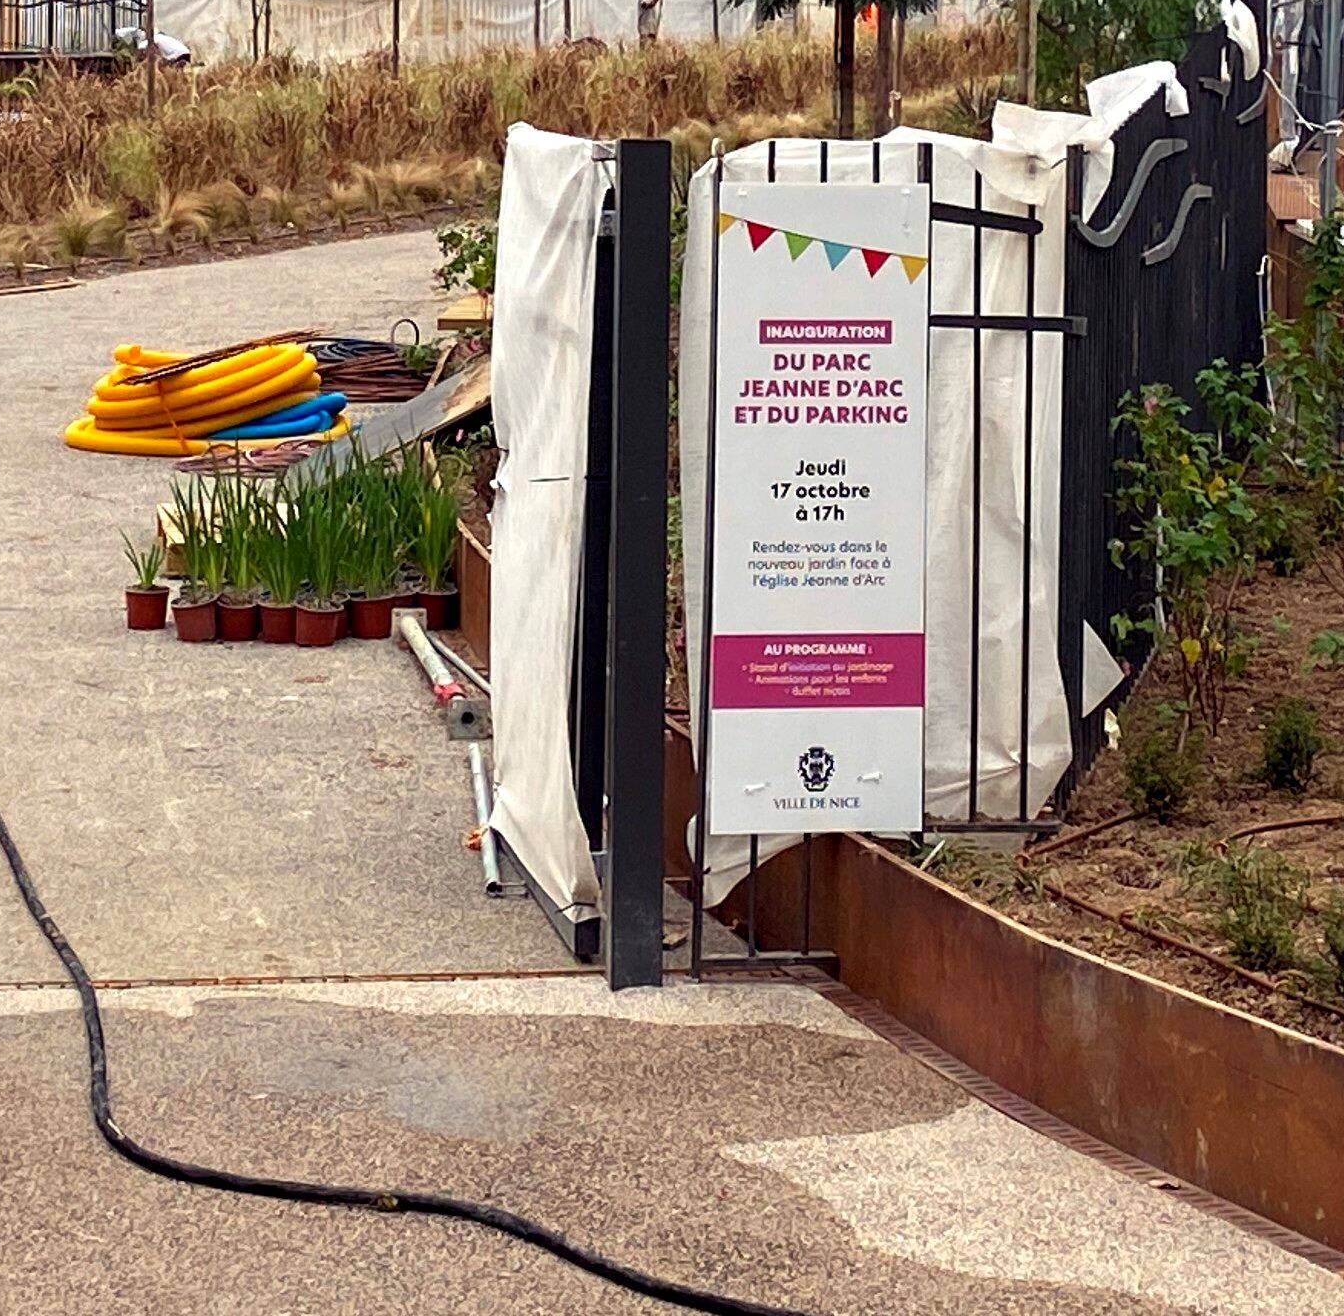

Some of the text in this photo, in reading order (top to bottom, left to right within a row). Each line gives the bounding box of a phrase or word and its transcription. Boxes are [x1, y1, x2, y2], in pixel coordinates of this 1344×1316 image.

[766, 325, 886, 339] INAUGURATION
[774, 353, 872, 371] DU PARC
[739, 379, 903, 397] JEANNE D'ARC
[734, 405, 909, 424] ET DU PARKING
[795, 458, 846, 476] Jeudi
[770, 481, 871, 499] 17 octobre
[795, 504, 845, 521] à 17h
[752, 540, 888, 553] Rendez-vous dans le
[747, 556, 892, 572] nouveau jardin face à
[752, 573, 886, 589] l'église Jeanne d'Arc
[763, 643, 783, 656] AU
[784, 642, 867, 655] PROGRAMME
[773, 796, 861, 809] VILLE DE NICE
